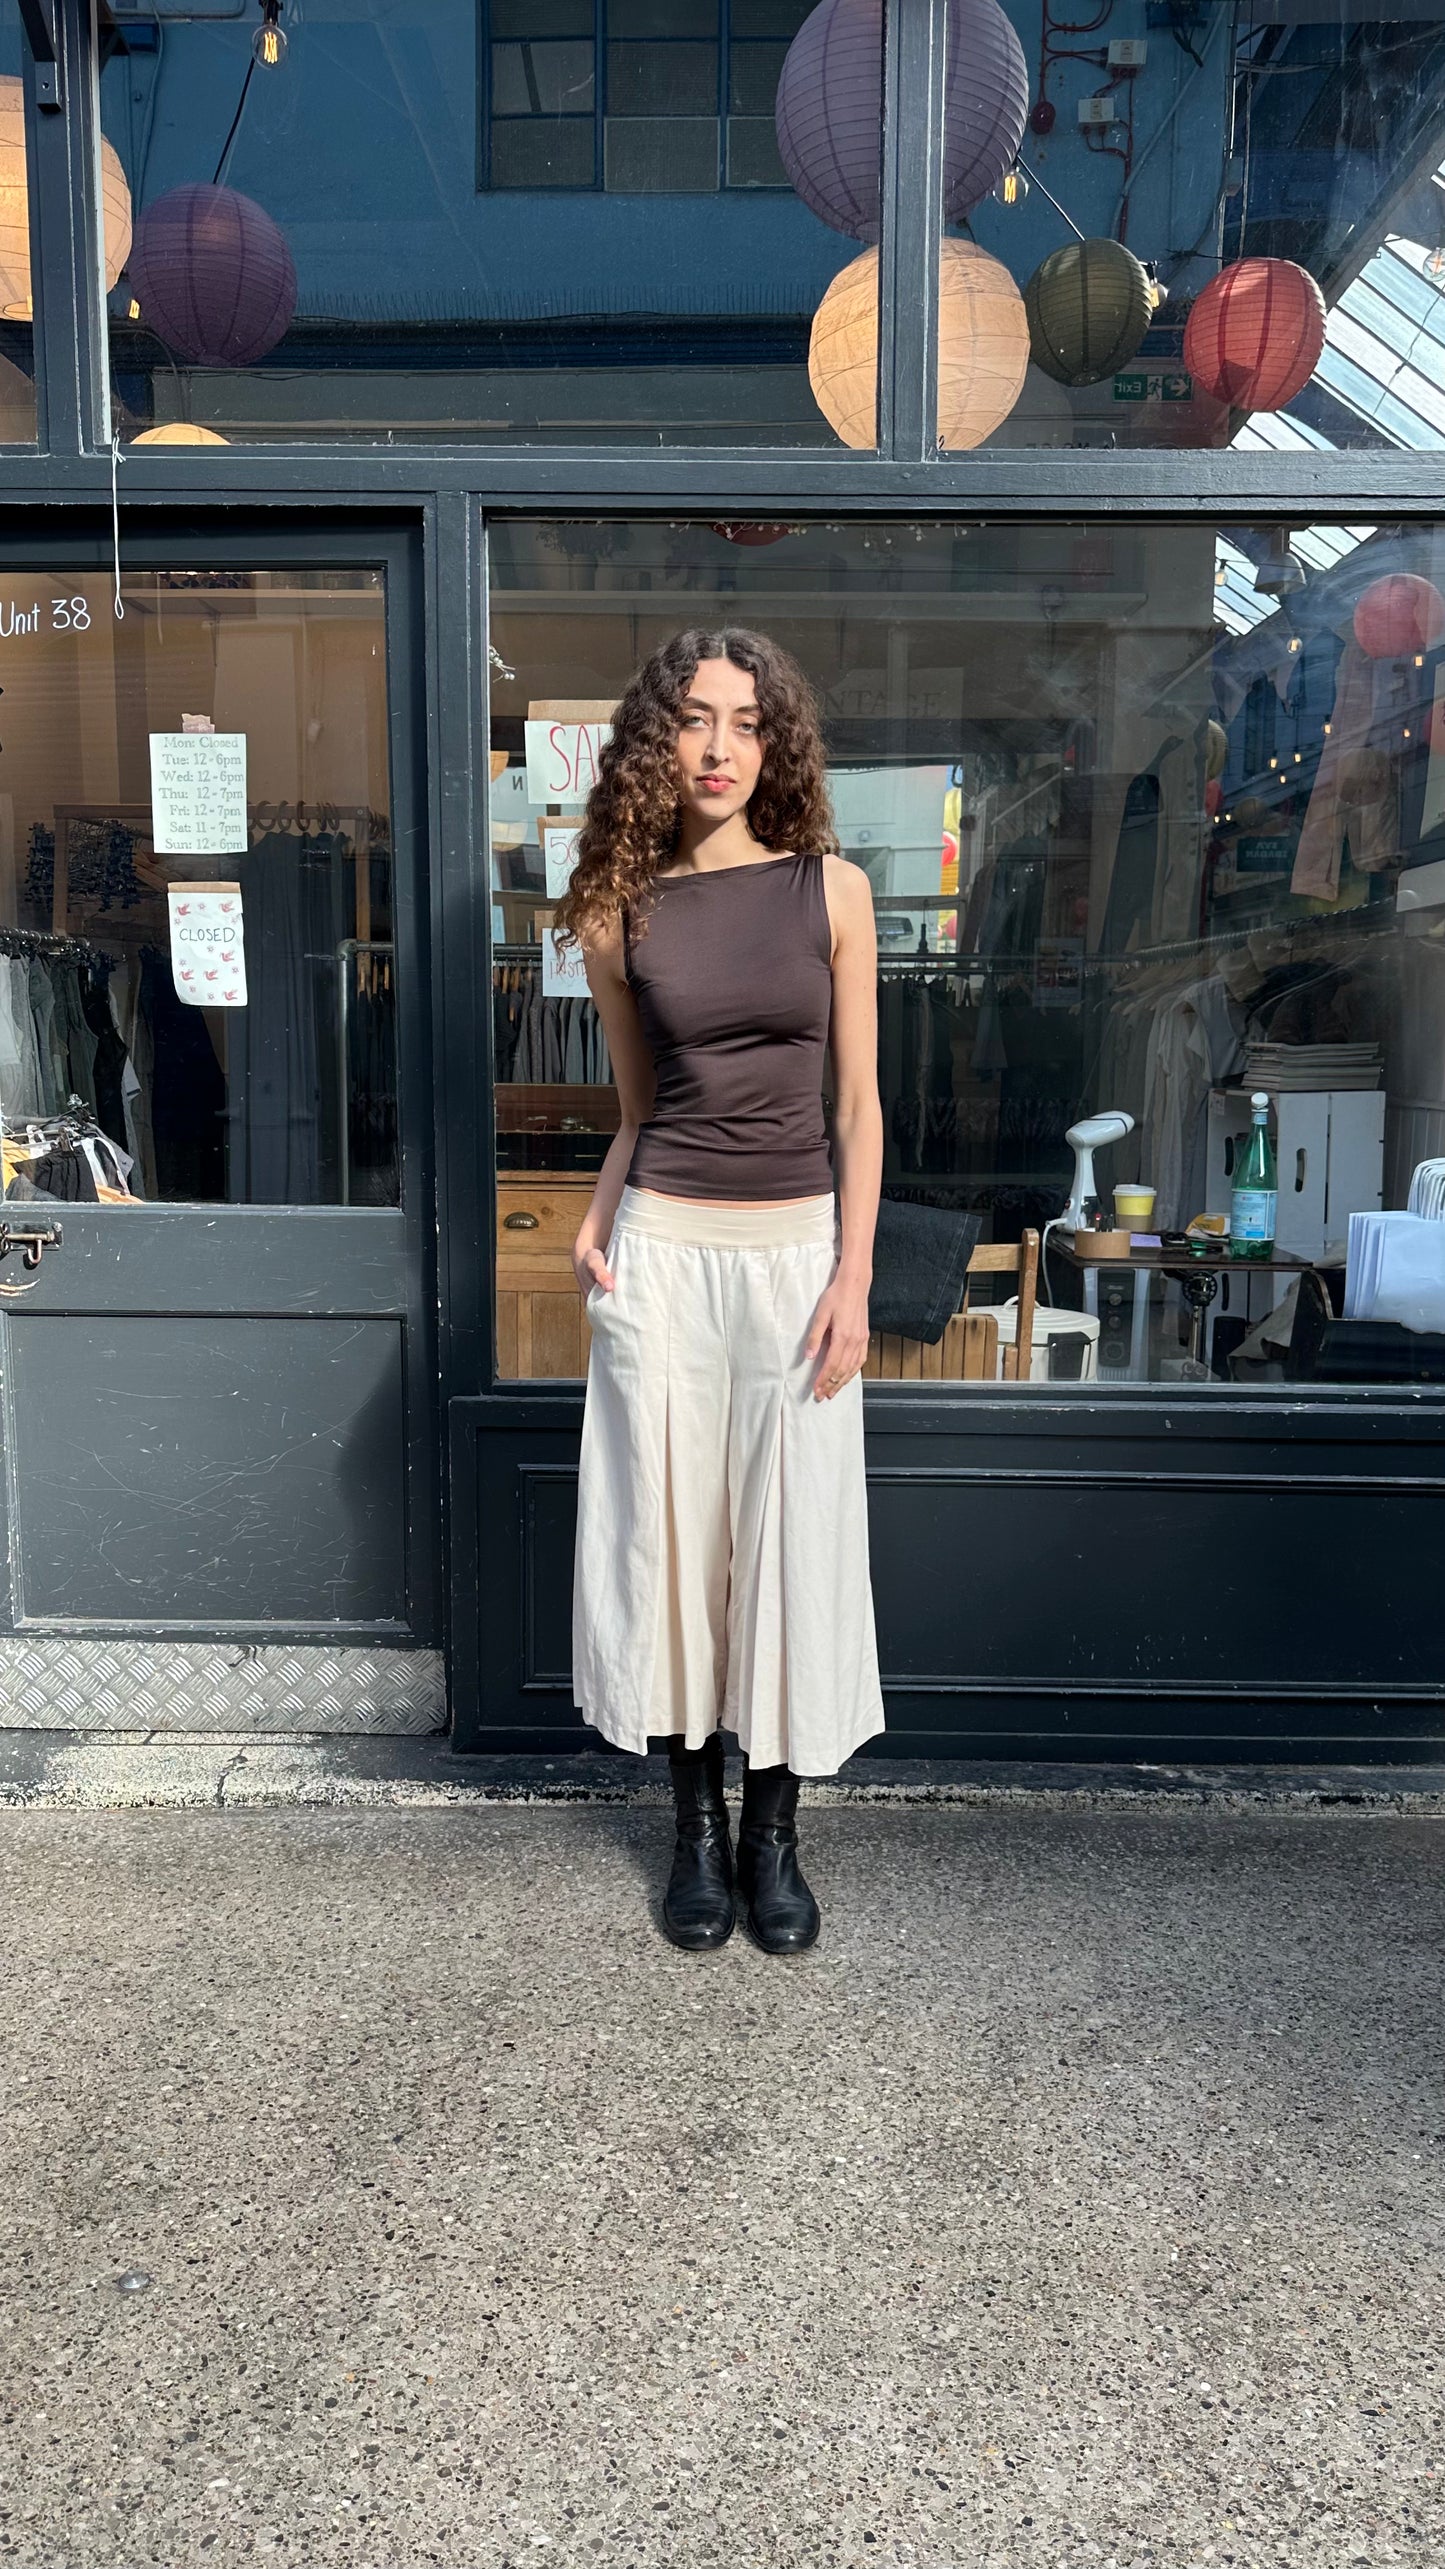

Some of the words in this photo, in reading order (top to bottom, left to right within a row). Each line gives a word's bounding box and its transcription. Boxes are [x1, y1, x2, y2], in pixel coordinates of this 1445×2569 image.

[0, 601, 41, 637] Unit
[51, 596, 91, 630] 38
[163, 736, 195, 748] Mon:
[199, 736, 239, 748] Closed
[162, 754, 190, 765] Tue:
[549, 723, 602, 792] SA
[161, 770, 194, 782] Wed:
[158, 787, 189, 799] Thu:
[169, 804, 190, 816] Fri:
[169, 821, 192, 833] Sat:
[165, 838, 192, 850] Sun:
[179, 927, 236, 943] CLOSED
